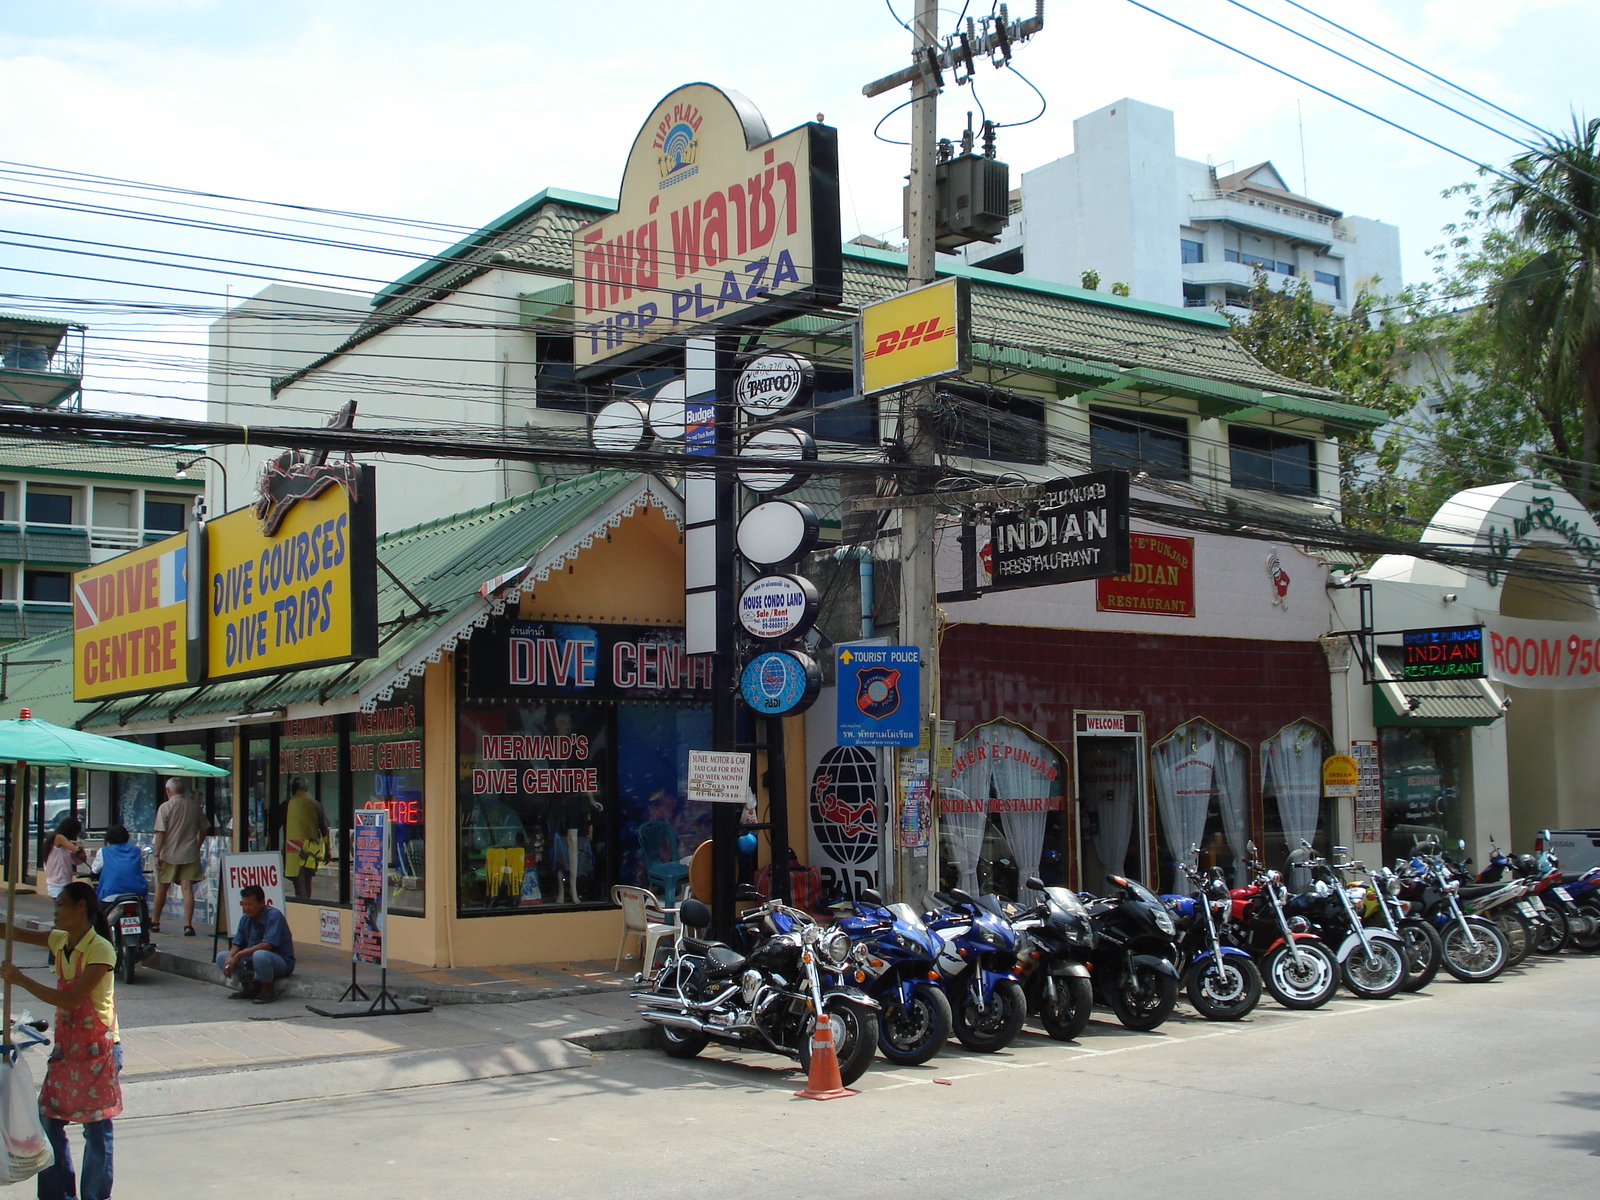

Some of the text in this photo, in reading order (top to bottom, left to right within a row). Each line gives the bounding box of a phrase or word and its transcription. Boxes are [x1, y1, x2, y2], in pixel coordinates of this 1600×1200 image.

[652, 103, 703, 149] TIPP PLAZA
[585, 249, 799, 355] TIPP PLAZA
[875, 316, 945, 357] DHL
[747, 374, 793, 399] TATTOO
[686, 406, 715, 424] Budget
[997, 508, 1107, 553] INDIAN
[213, 512, 347, 617] DIVE COURSES
[1000, 547, 1101, 576] RESTAURANT
[1150, 539, 1188, 569] PUNJAB
[99, 558, 160, 622] DIVE
[743, 592, 803, 610] HOUSE CONDO LAND
[1107, 595, 1186, 611] RESTAURANT
[225, 580, 332, 668] DIVE TRIPS
[756, 609, 769, 618] Sale
[773, 608, 788, 616] Rent
[83, 620, 177, 685] CENTRE
[509, 637, 595, 687] DIVE
[854, 652, 918, 662] TOURIST POLICE
[1407, 643, 1477, 662] INDIAN
[1490, 631, 1562, 677] ROOM
[1404, 662, 1482, 677] RESTAURANT
[765, 699, 780, 708] PADI
[1087, 717, 1124, 731] WELCOME
[351, 740, 421, 771] DIVE CENTRE
[483, 734, 589, 760] MERMAID'S
[710, 756, 729, 764] MOTOR
[736, 757, 746, 765] CAR
[1004, 746, 1058, 781] PUNJAB
[374, 774, 406, 799] DIVE
[473, 768, 598, 794] DIVE CENTRE
[989, 797, 1066, 812] RESTAURANT
[229, 865, 278, 889] FISHING
